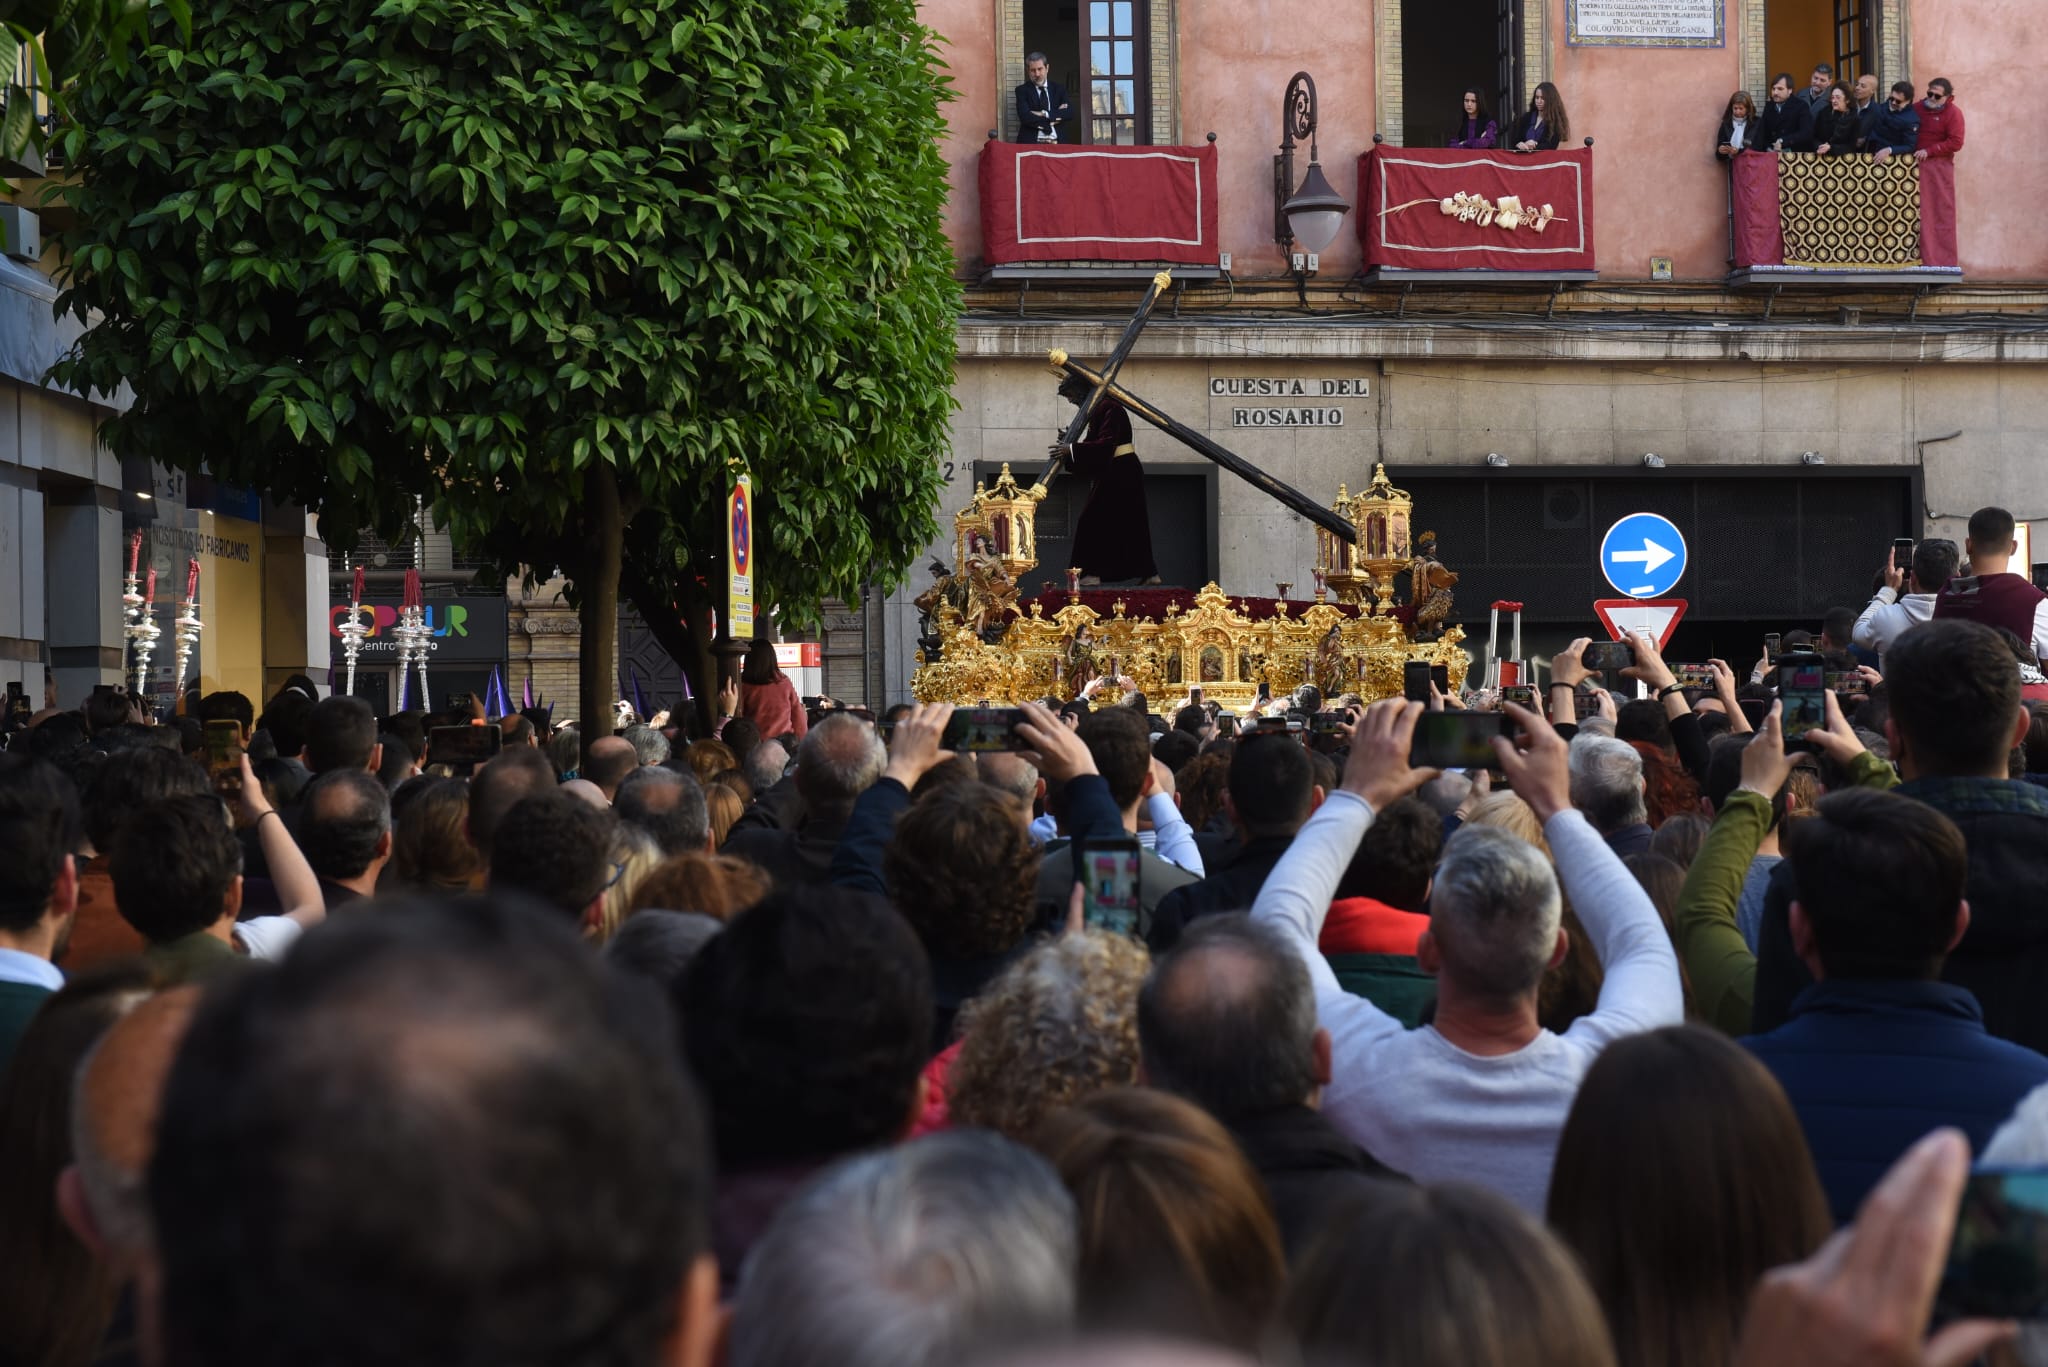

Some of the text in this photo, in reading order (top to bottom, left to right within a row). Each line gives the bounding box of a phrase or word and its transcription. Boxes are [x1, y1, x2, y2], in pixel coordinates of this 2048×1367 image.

[1625, 25, 1635, 33] DE
[1211, 378, 1367, 396] CUESTA DEL
[1234, 408, 1342, 426] ROSARIO
[152, 523, 194, 551] NOSOTROS
[195, 533, 205, 553] LO
[206, 535, 250, 562] FABRICAMOS
